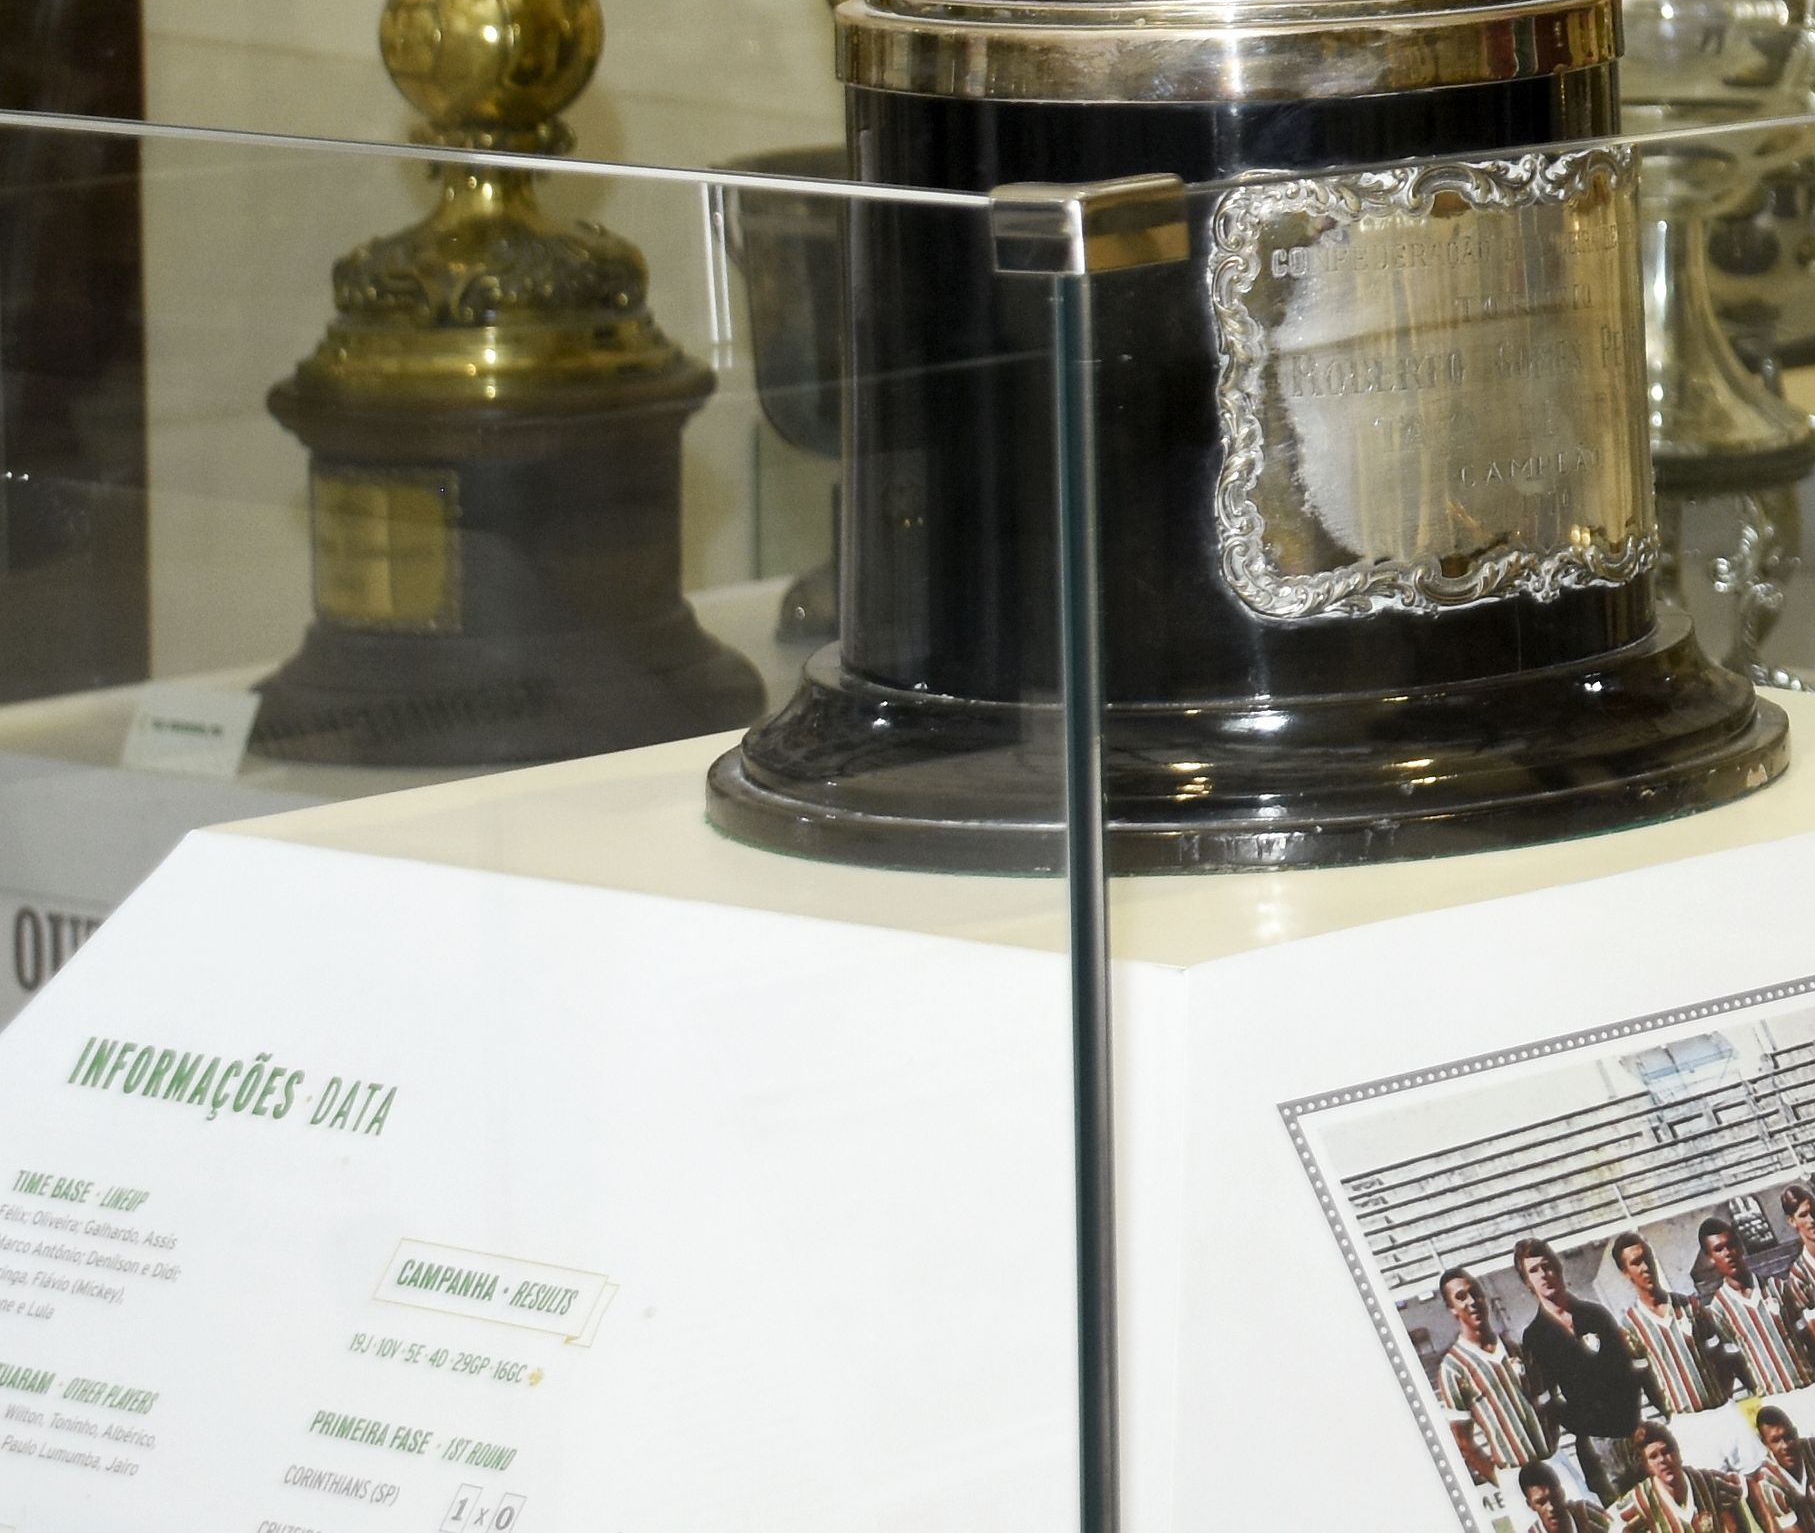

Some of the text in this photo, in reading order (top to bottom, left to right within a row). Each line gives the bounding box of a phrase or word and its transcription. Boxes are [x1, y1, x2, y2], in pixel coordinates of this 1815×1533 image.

[68, 1037, 398, 1136] INFORMAÇÕES DATA
[12, 1170, 150, 1212] TIME BASE LINEUP
[143, 1230, 179, 1250] Assis
[32, 1269, 71, 1292] Flávio
[86, 1250, 140, 1274] Denilson
[140, 1264, 151, 1276] e
[396, 1258, 579, 1316] CAMPANHA RESULTS
[16, 1301, 27, 1315] e
[27, 1301, 55, 1320] Lula
[63, 1376, 108, 1405] OTHER
[102, 1384, 160, 1415] PLAYERS
[1, 1433, 37, 1455] Paulo
[105, 1456, 140, 1476] Jairo
[309, 1410, 518, 1472] PRIMEIRA FASE 1ST ROUND
[284, 1464, 400, 1507] CORINTHIANS (SP)
[451, 1497, 469, 1521] 1
[495, 1505, 515, 1531] 0
